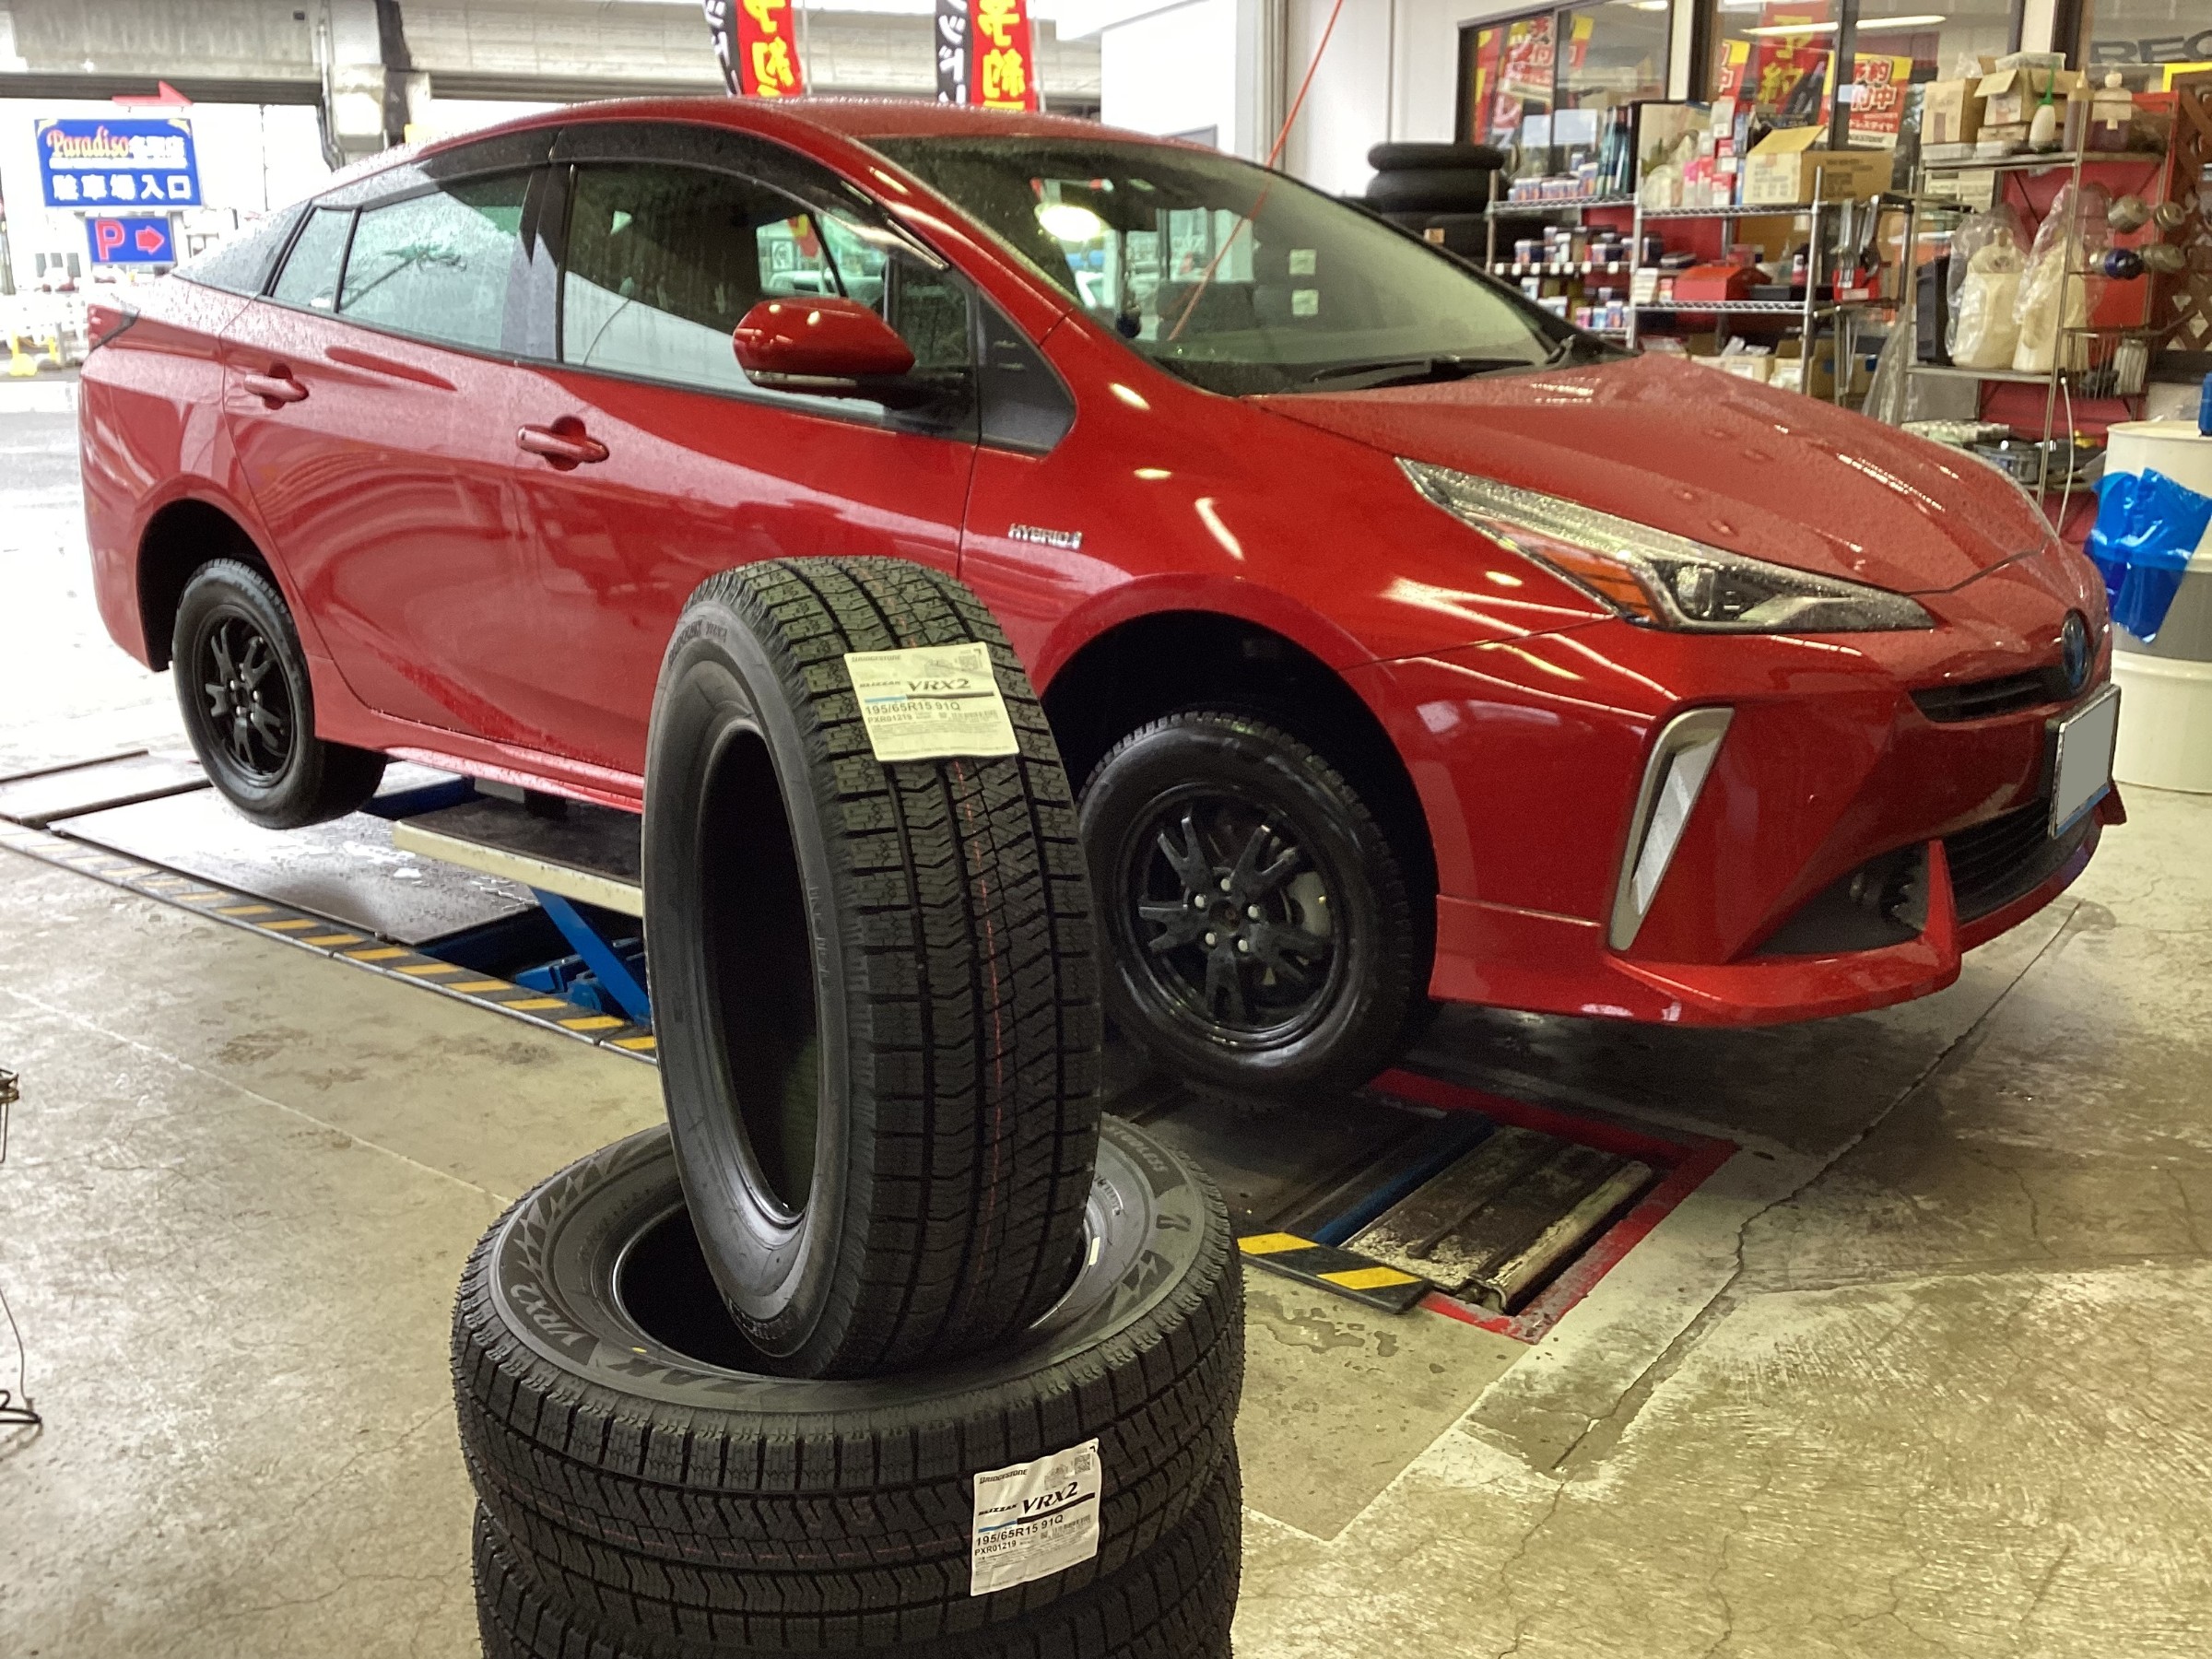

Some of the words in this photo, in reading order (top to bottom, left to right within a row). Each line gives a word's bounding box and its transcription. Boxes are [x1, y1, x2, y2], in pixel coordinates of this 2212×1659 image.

[46, 124, 130, 158] Paradiso
[95, 218, 125, 262] P
[907, 678, 971, 691] VRX2
[865, 702, 932, 714] 195/65R15
[935, 701, 960, 712] 91Q
[509, 1281, 586, 1347] VRX2
[979, 1469, 1029, 1484] BRIDGESTONE
[1022, 1481, 1078, 1513] VRX2
[976, 1523, 1039, 1547] 195/65R15
[1041, 1514, 1064, 1530] 91Q
[974, 1540, 1017, 1556] PXR01219
